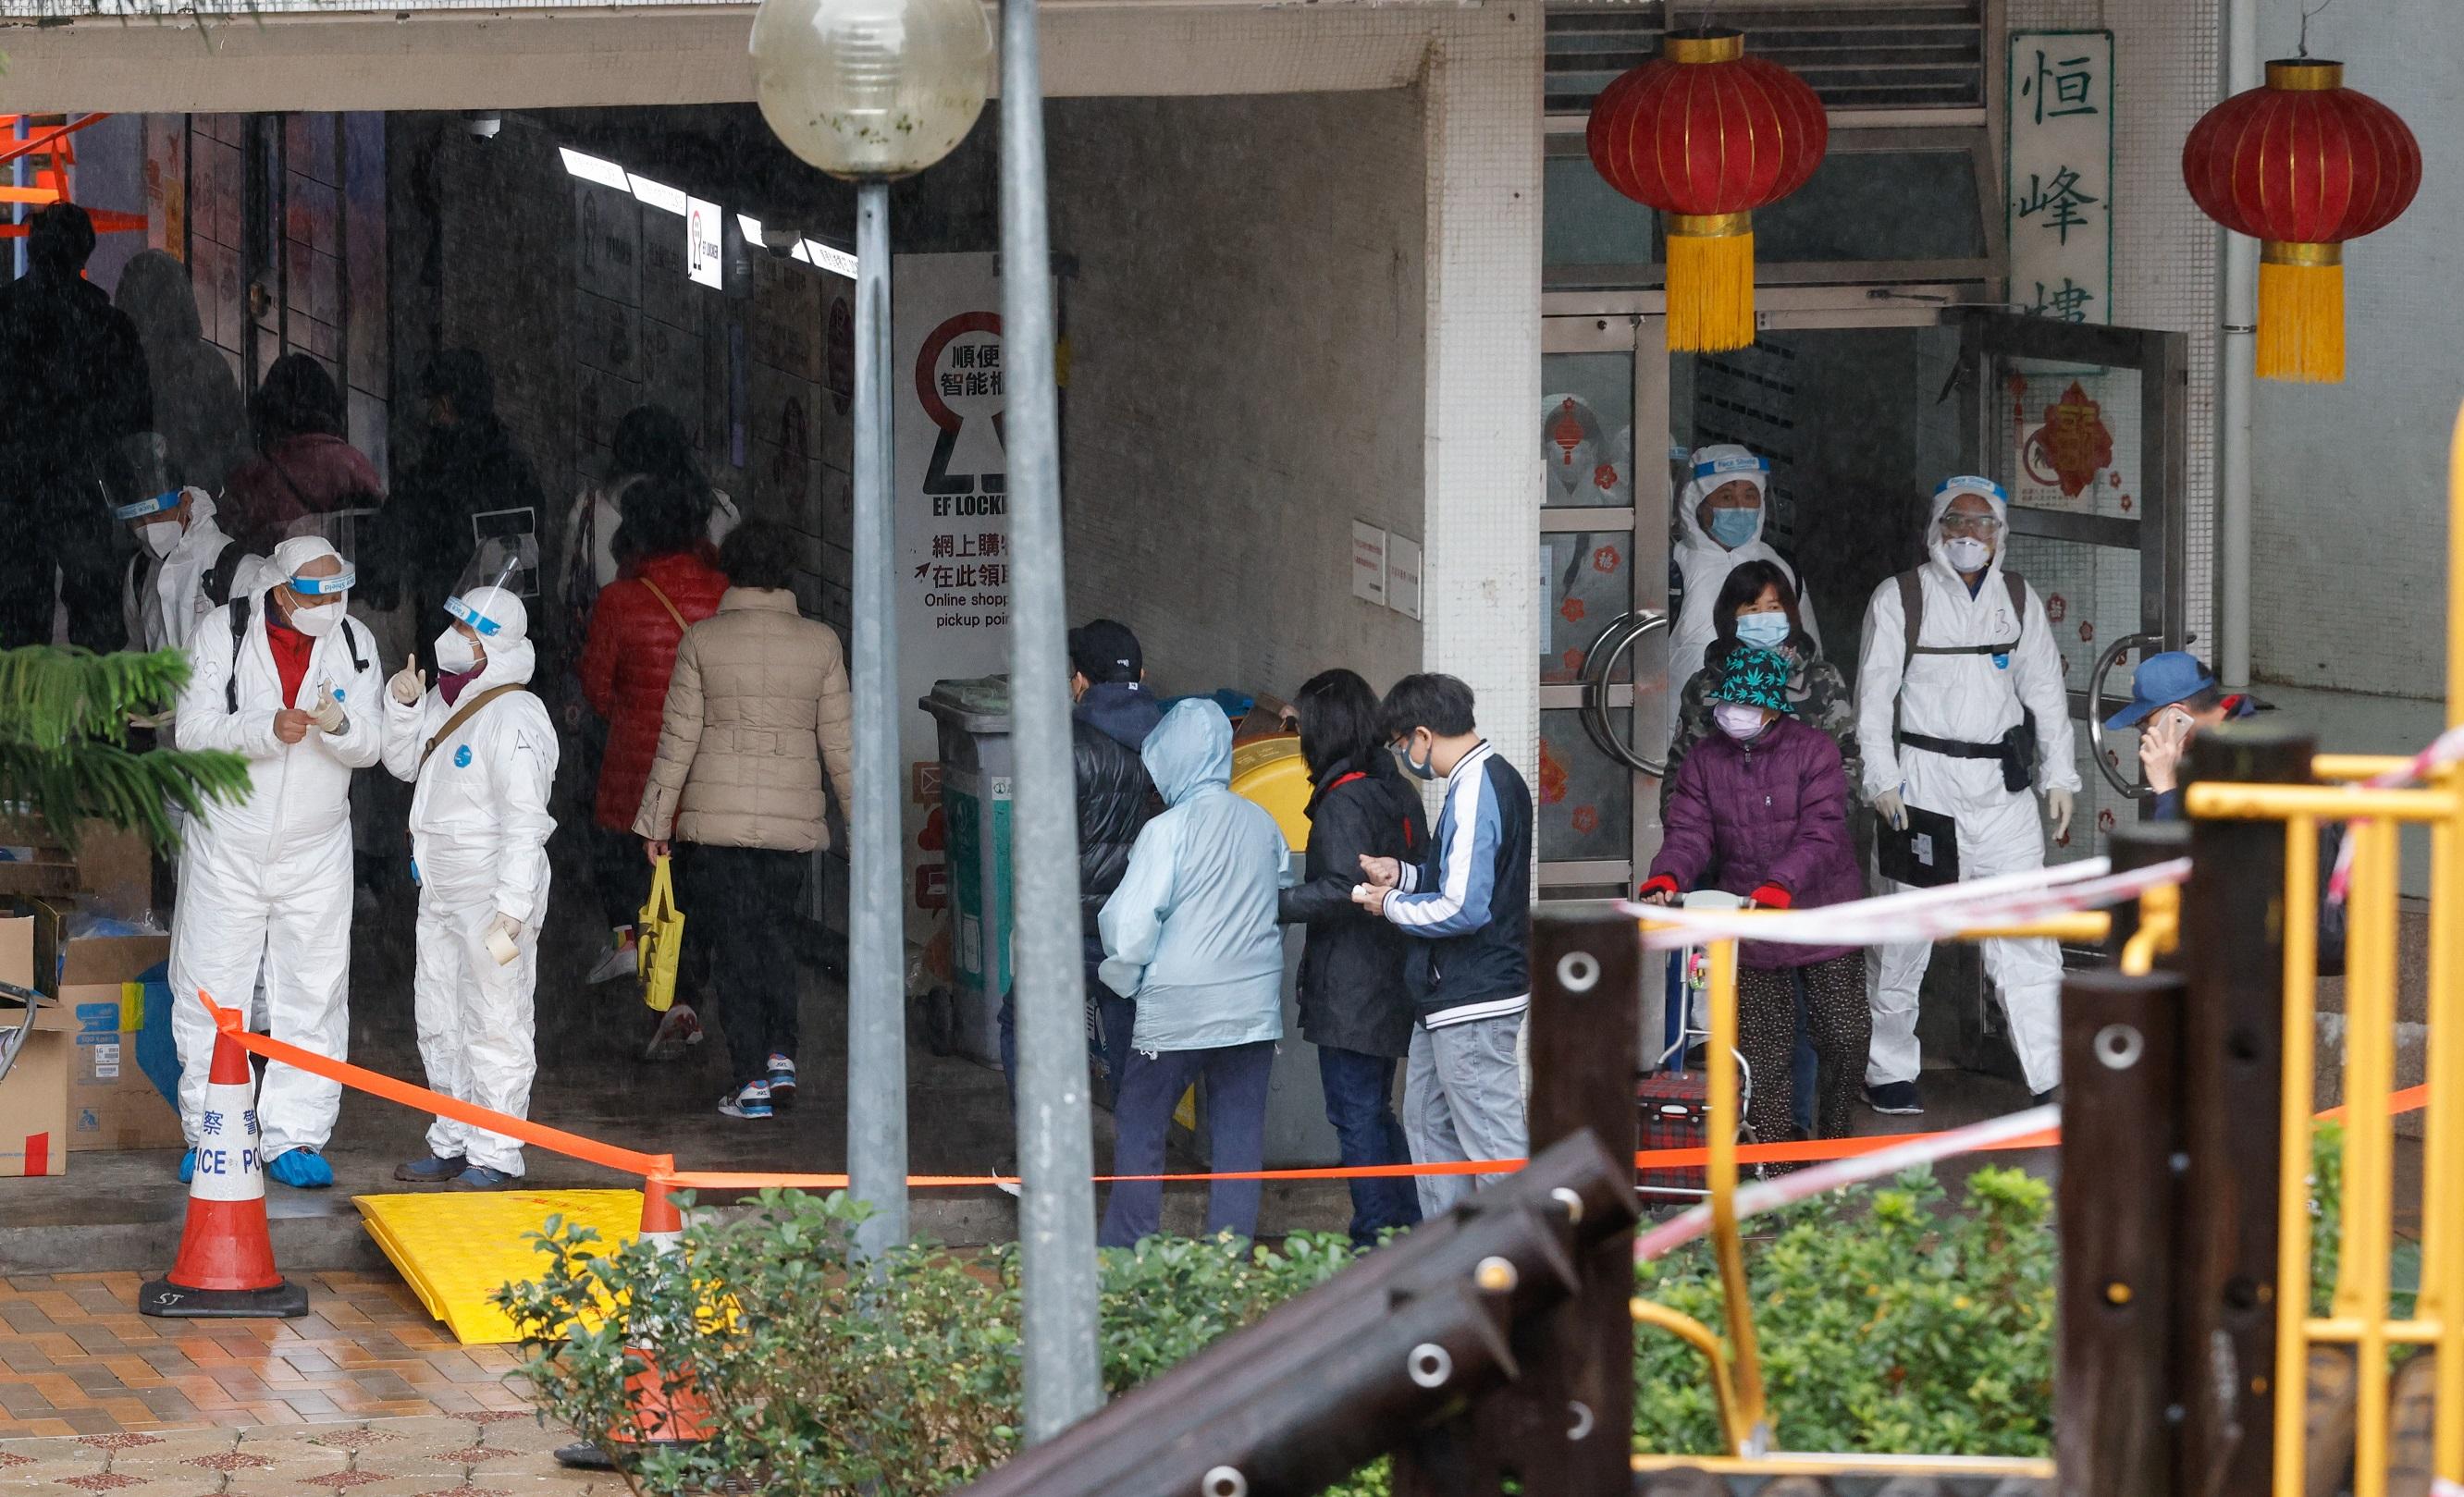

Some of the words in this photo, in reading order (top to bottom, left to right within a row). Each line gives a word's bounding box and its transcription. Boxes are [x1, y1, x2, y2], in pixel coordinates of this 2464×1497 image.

[952, 345, 1000, 369] 順便
[933, 497, 952, 517] EF
[955, 495, 1007, 516] LOCK
[932, 533, 1008, 558] 網上購
[325, 582, 346, 593] Shield
[925, 593, 967, 607] Online
[936, 613, 980, 629] pickup
[203, 1110, 224, 1135] 察
[196, 1147, 227, 1175] ICE
[242, 1147, 261, 1175] PO
